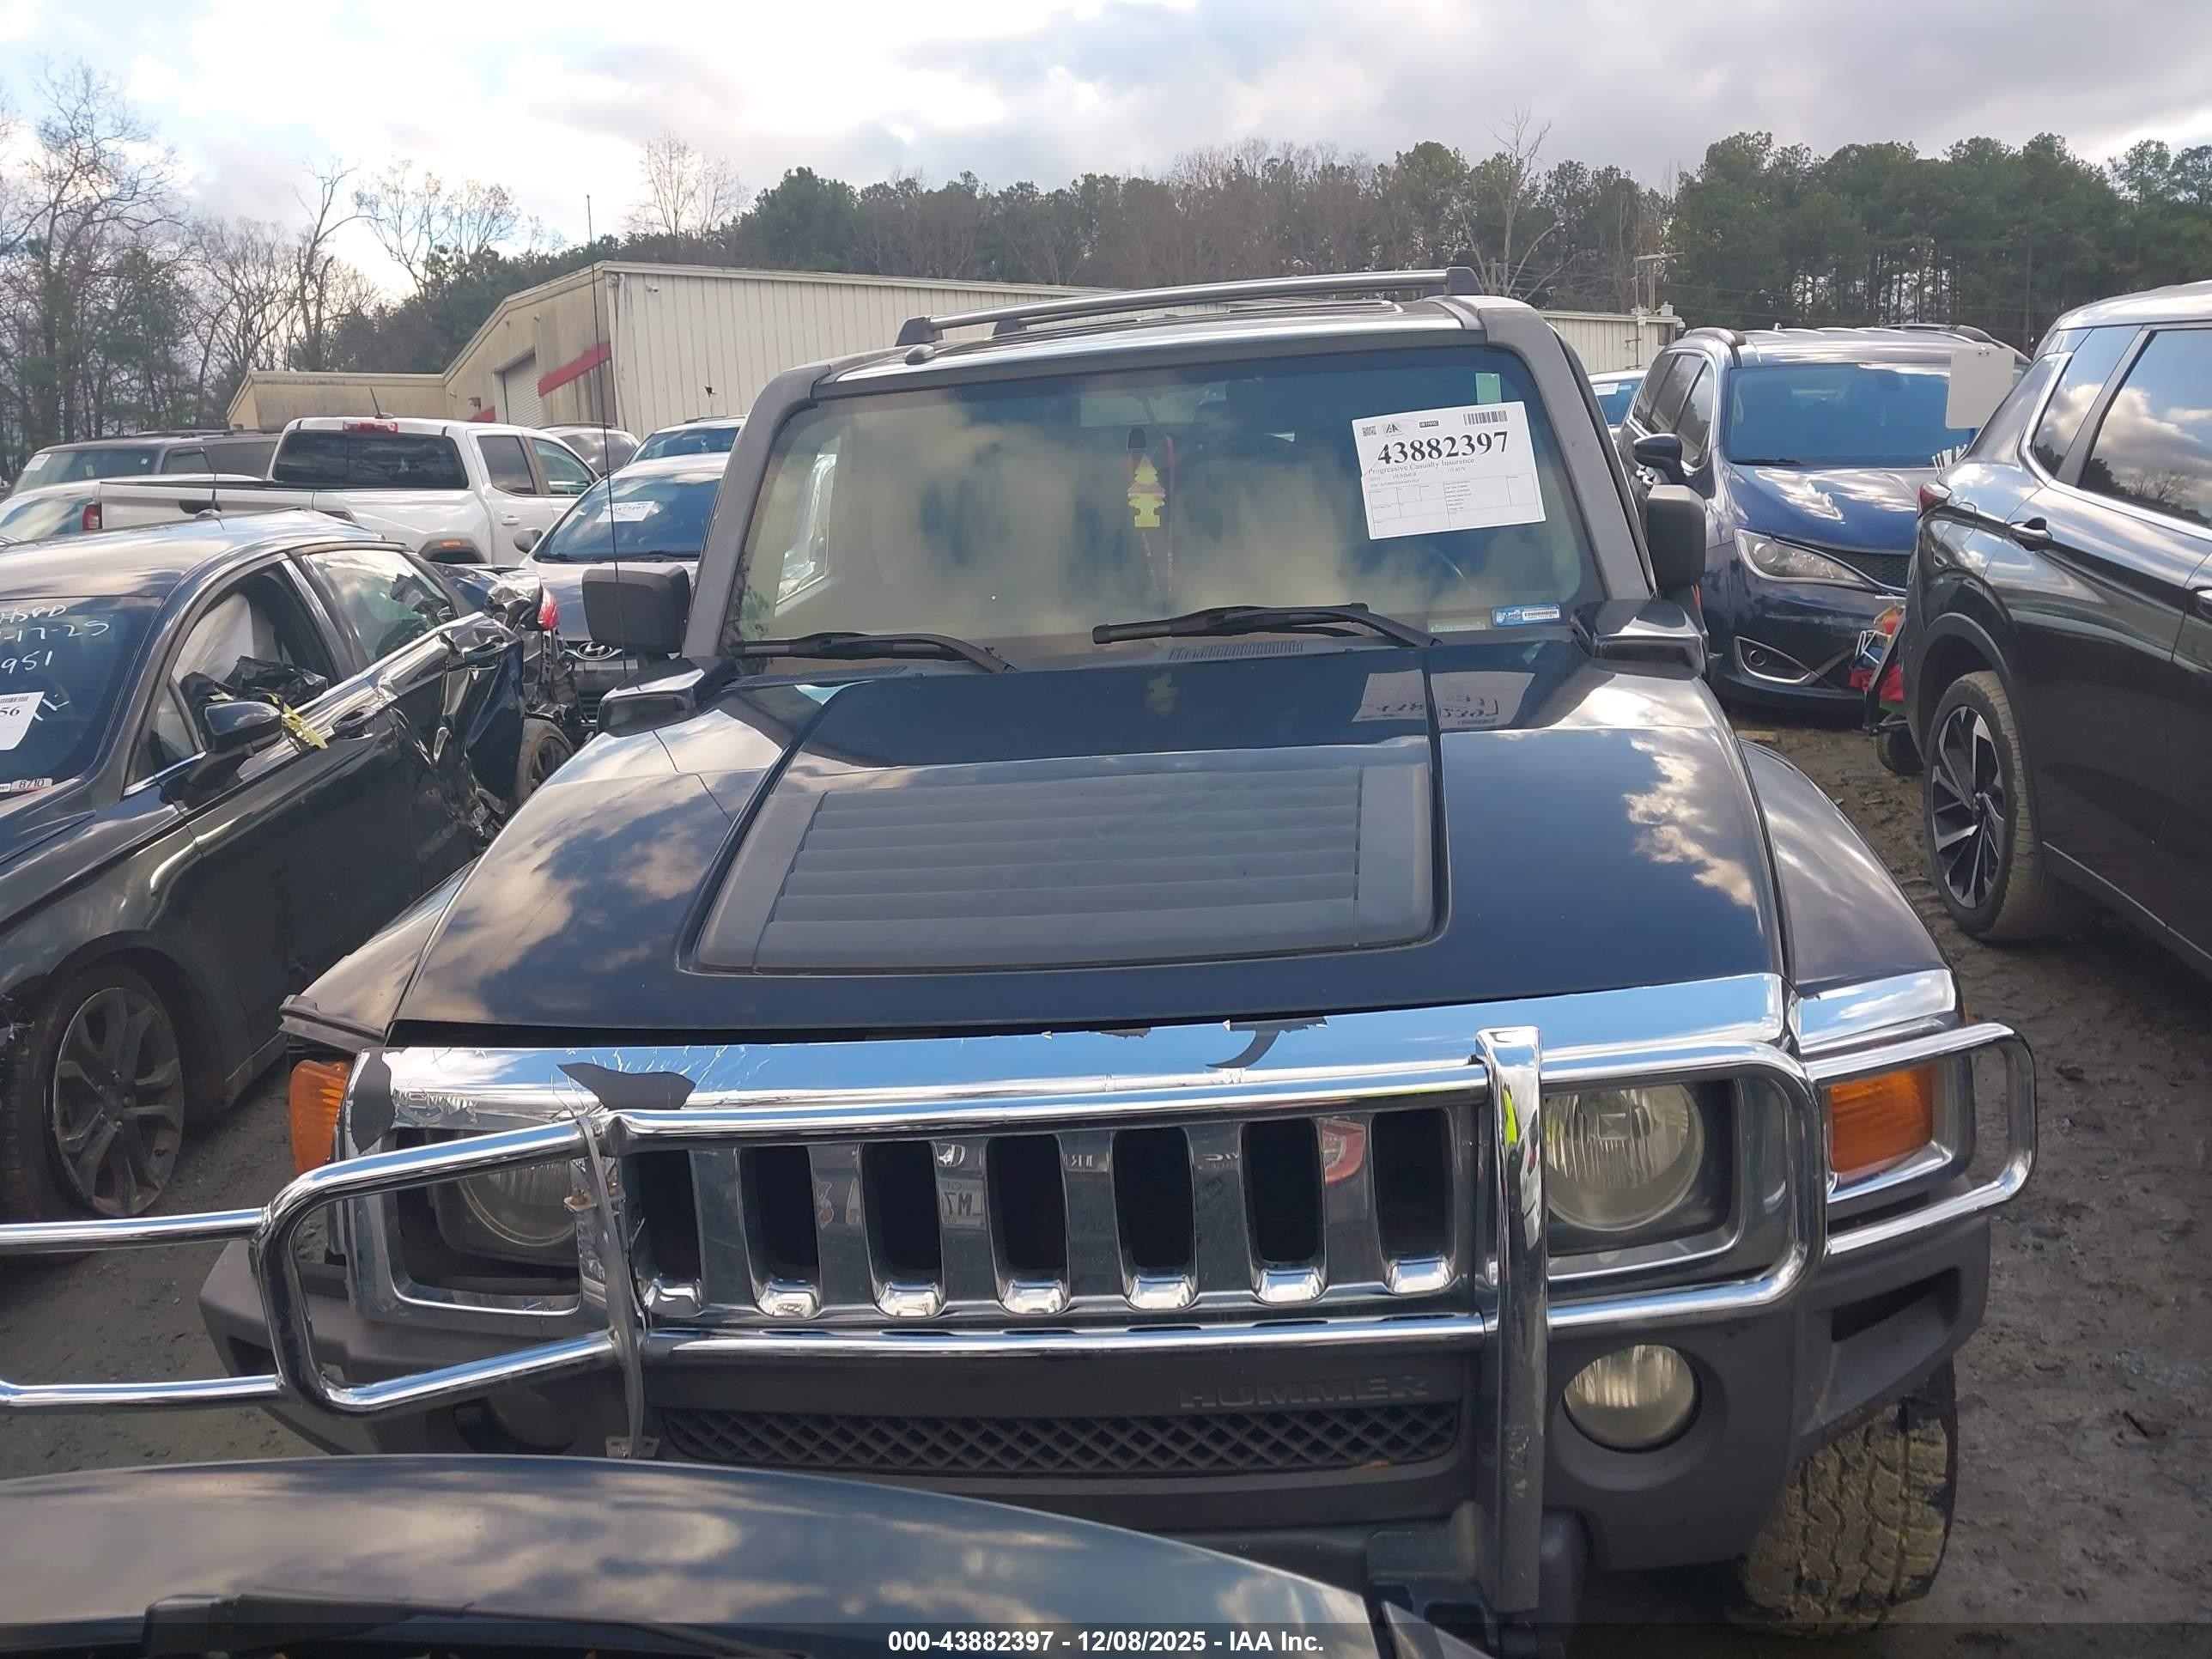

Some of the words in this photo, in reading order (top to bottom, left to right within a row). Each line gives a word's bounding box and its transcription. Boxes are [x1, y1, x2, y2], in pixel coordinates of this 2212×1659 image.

[1377, 431, 1508, 465] 43882397
[1368, 465, 1408, 475] Progressive
[1409, 461, 1439, 471] Casualty
[1441, 458, 1474, 466] Insurance
[1180, 1375, 1429, 1408] HUMMER
